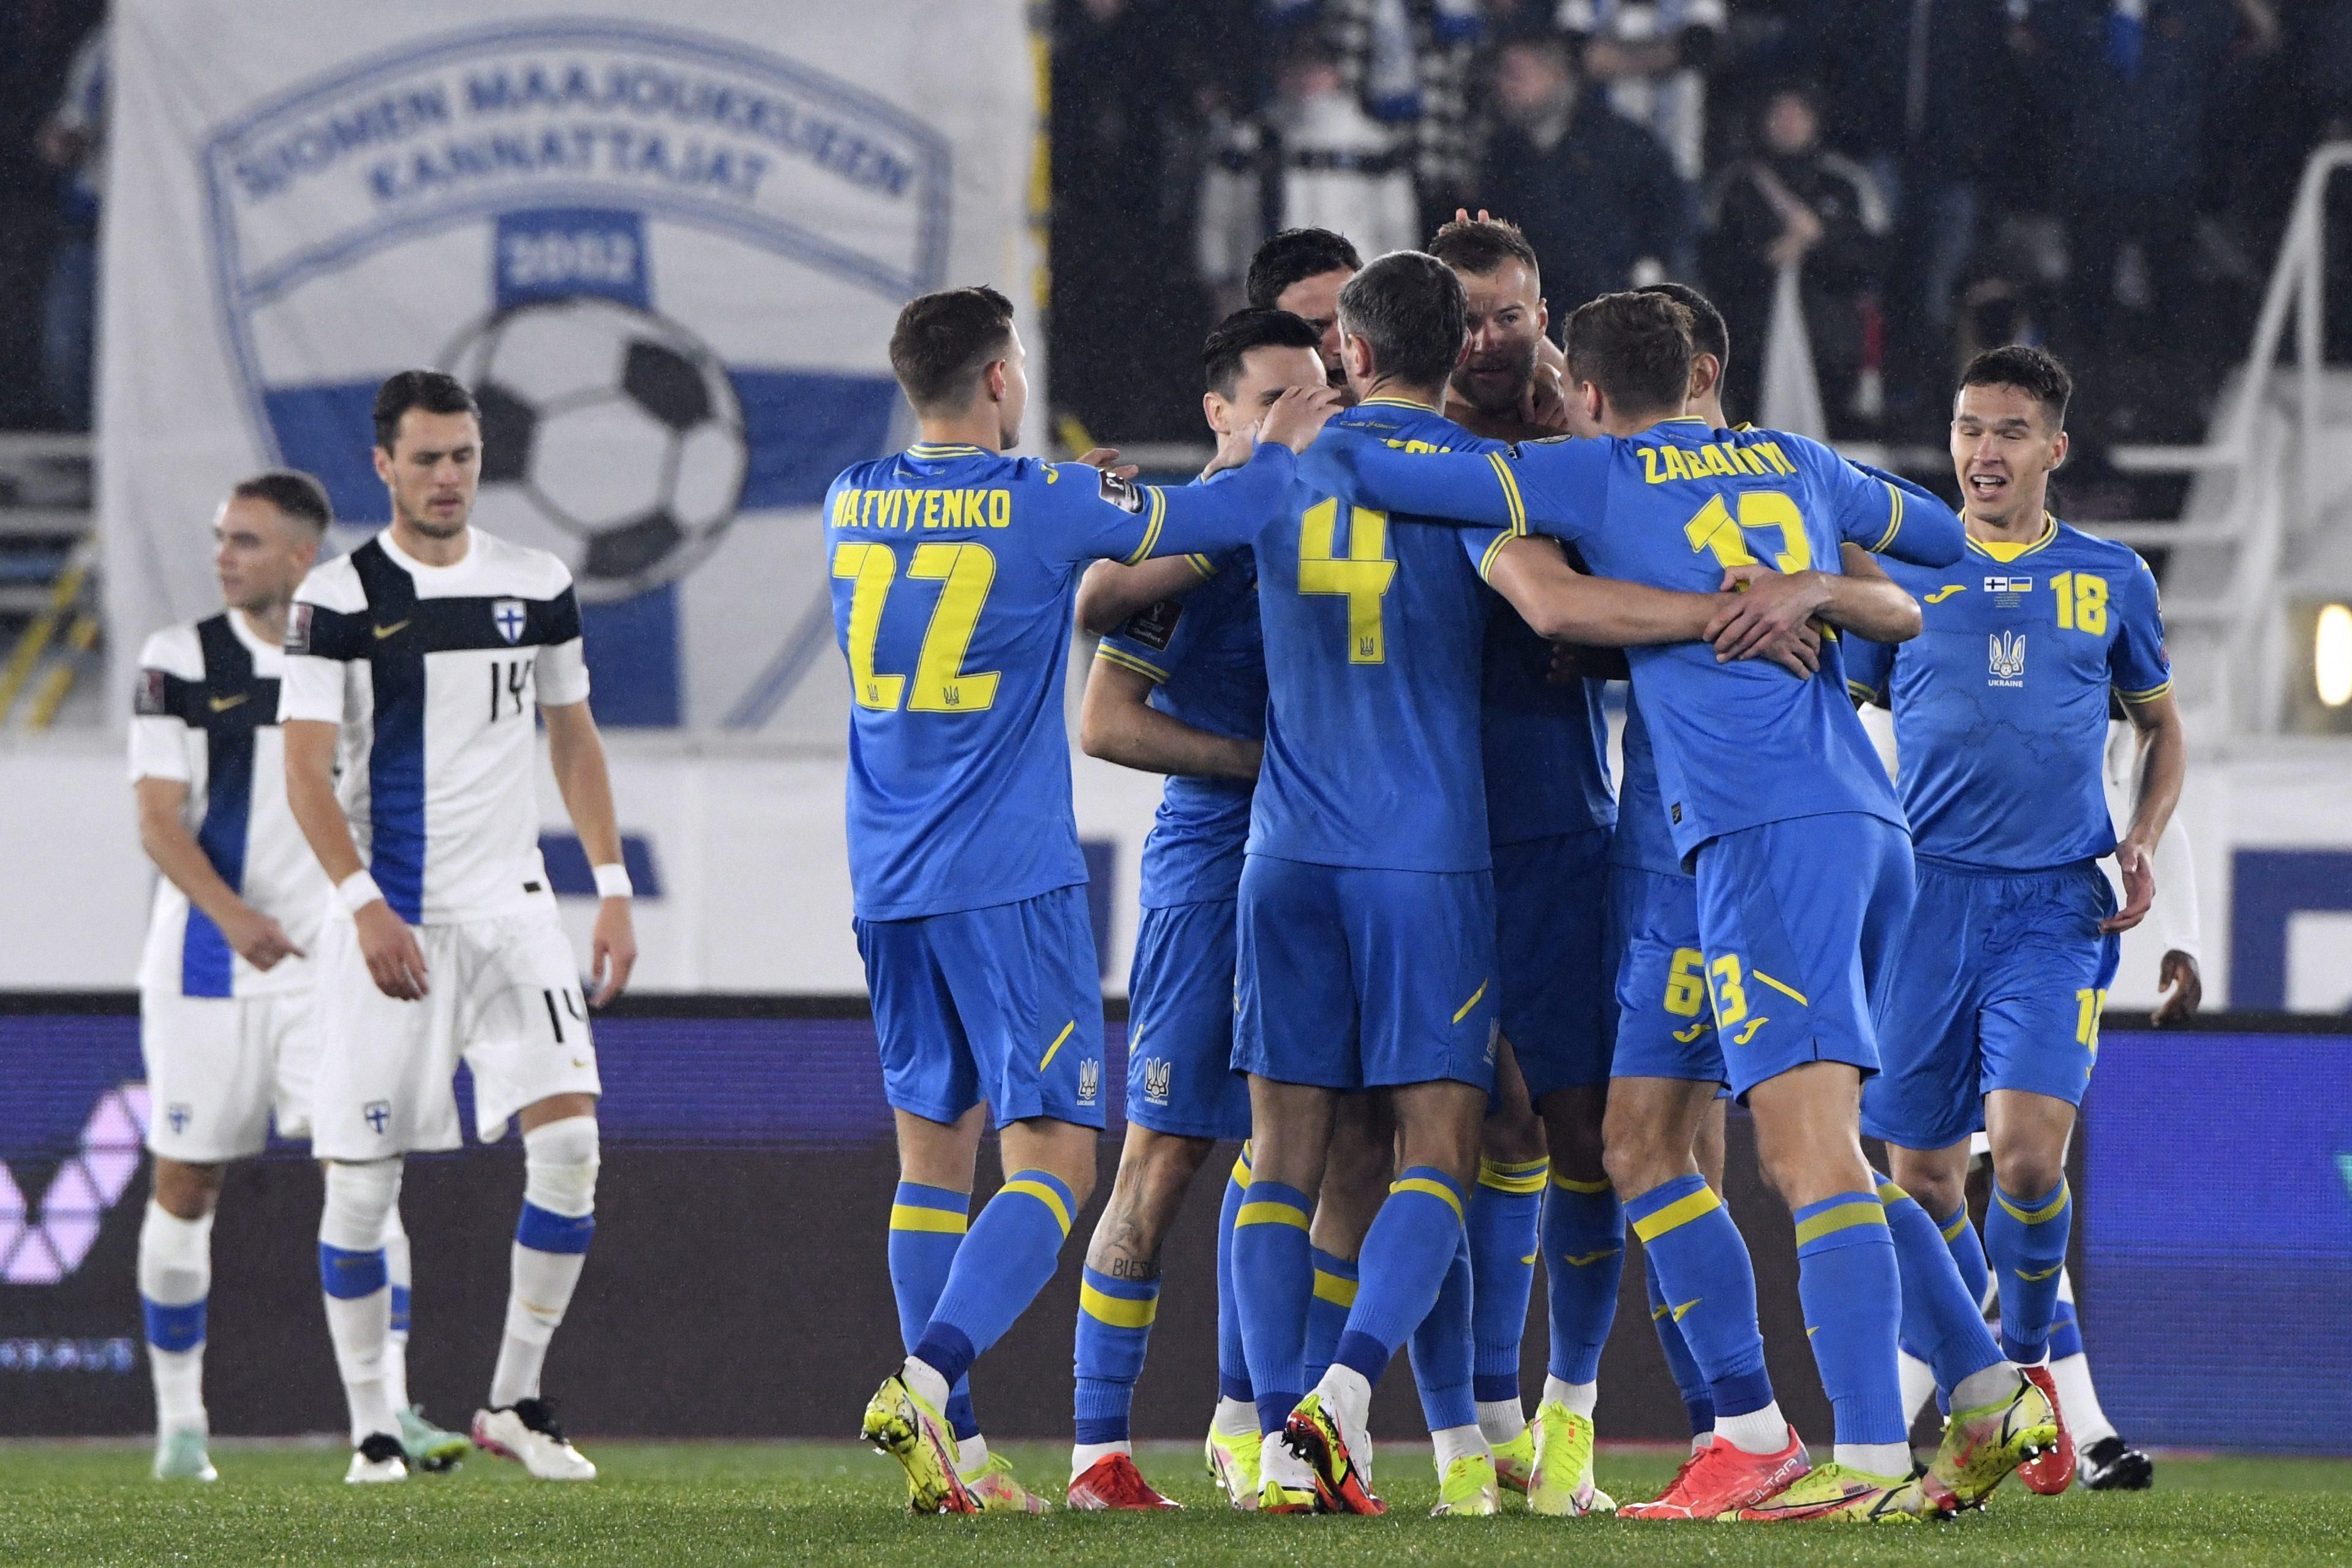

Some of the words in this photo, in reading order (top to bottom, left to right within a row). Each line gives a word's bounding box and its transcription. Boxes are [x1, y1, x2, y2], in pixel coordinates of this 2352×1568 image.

[370, 126, 773, 202] KANNATTAJAT
[831, 489, 1011, 532] MATVIYENKO
[1297, 496, 1398, 665] 4
[2049, 570, 2109, 636] 18
[832, 542, 1001, 712] 22
[491, 660, 533, 722] 14
[1664, 947, 1705, 1017] 6
[1705, 954, 1748, 1032] 3
[1747, 1458, 1798, 1505] ULTRA
